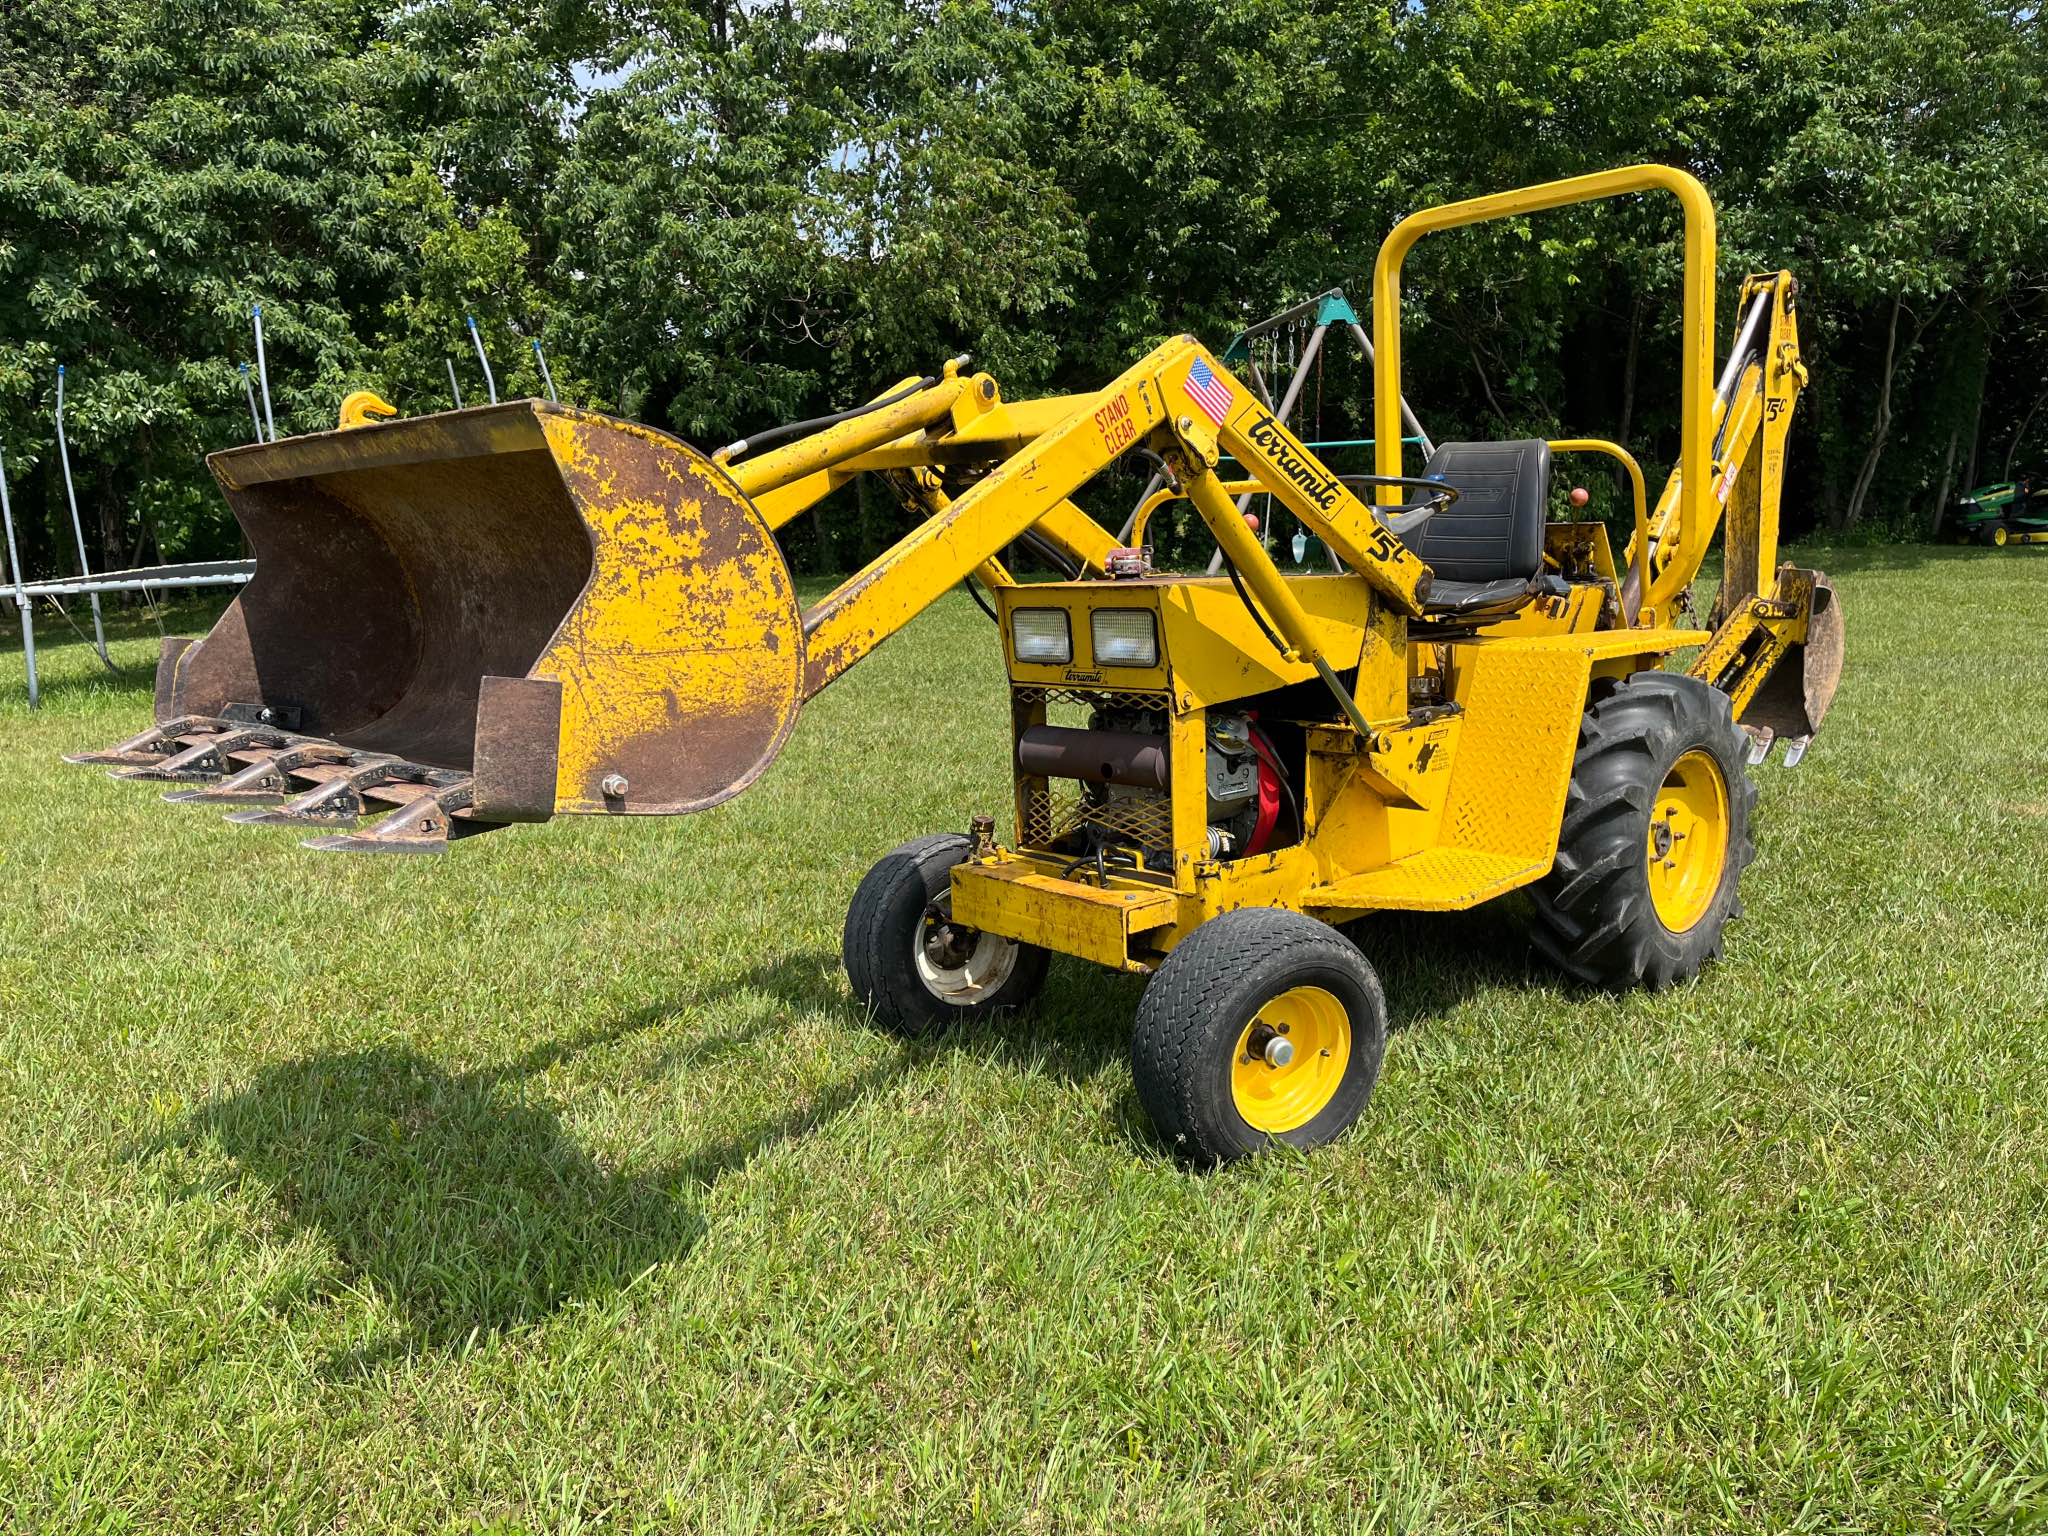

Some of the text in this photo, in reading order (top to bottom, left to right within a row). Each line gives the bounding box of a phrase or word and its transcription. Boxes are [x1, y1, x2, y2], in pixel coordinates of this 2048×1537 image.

[1094, 394, 1129, 434] STAND
[1766, 398, 1787, 421] T5C
[1104, 418, 1137, 455] CLEAR
[1248, 410, 1342, 511] terramite
